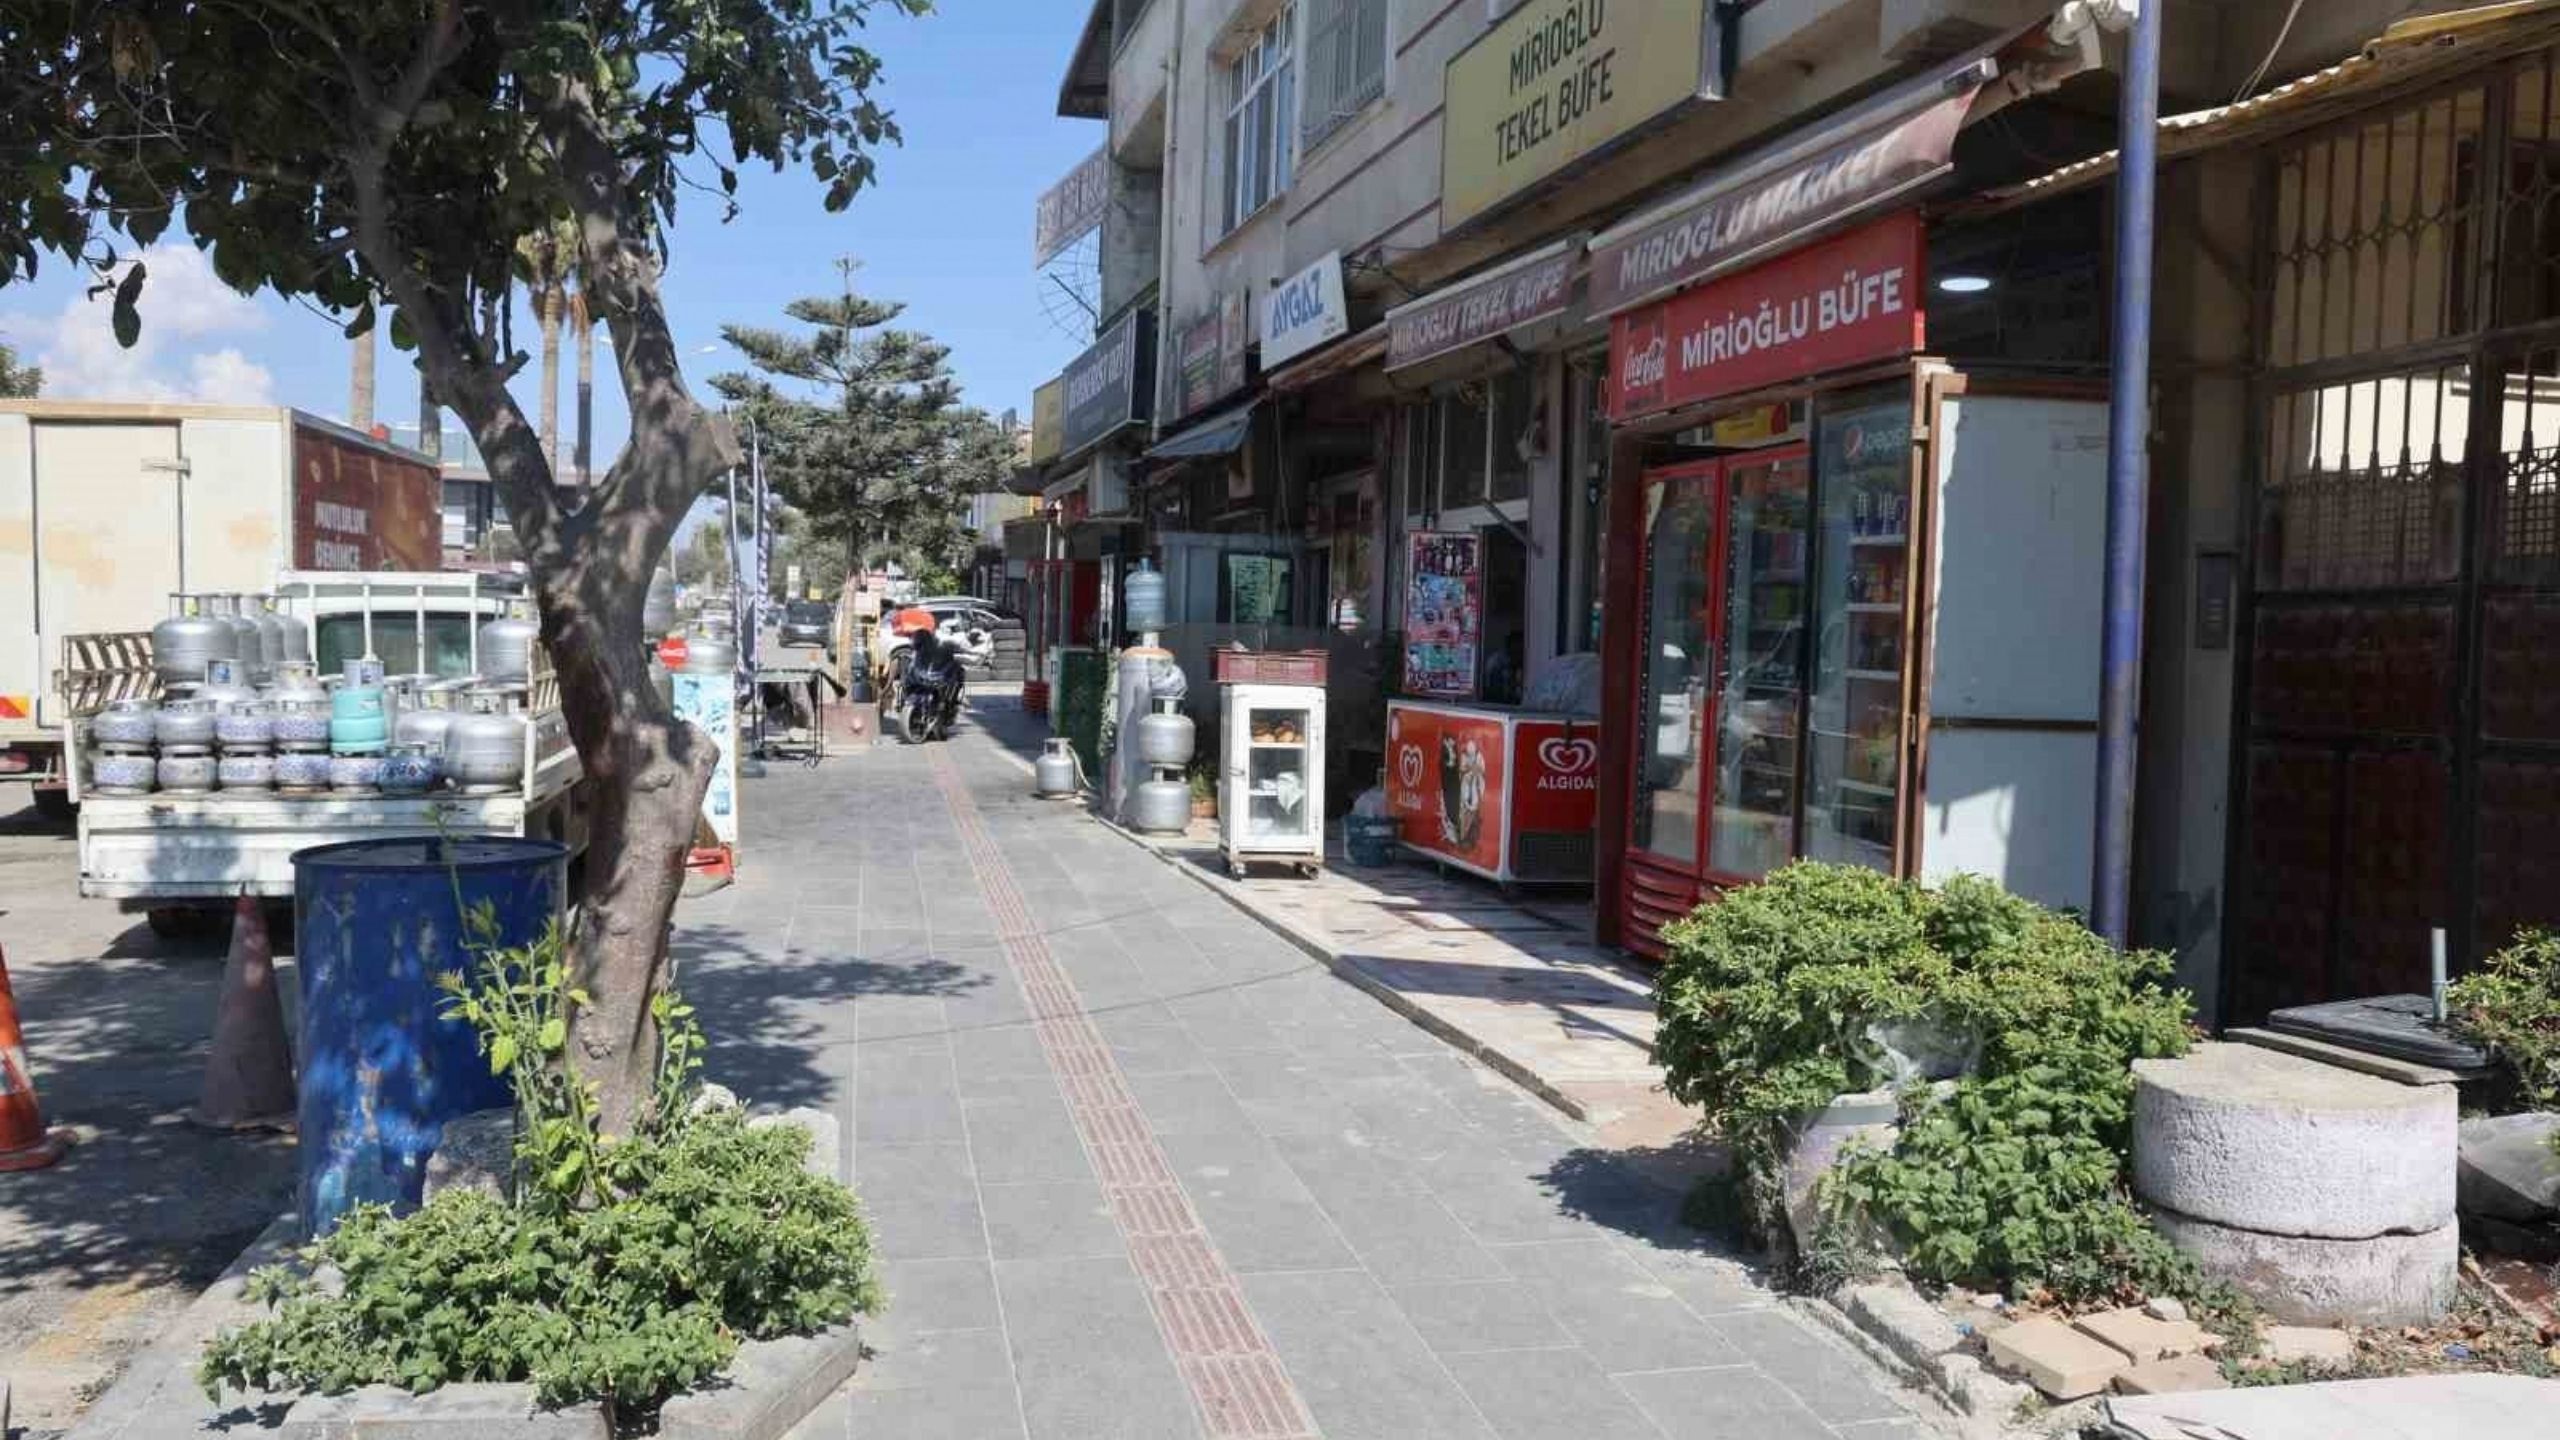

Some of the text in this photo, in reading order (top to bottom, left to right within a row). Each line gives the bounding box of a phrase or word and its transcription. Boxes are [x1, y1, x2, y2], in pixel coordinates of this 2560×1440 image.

[1495, 47, 1616, 167] TEKEL BÜFE
[1752, 133, 1897, 233] MARKET
[1271, 268, 1325, 339] AYGAZ
[1682, 267, 1904, 371] MİRİOĞLU BÜFE
[1537, 775, 1595, 790] ALGIDA
